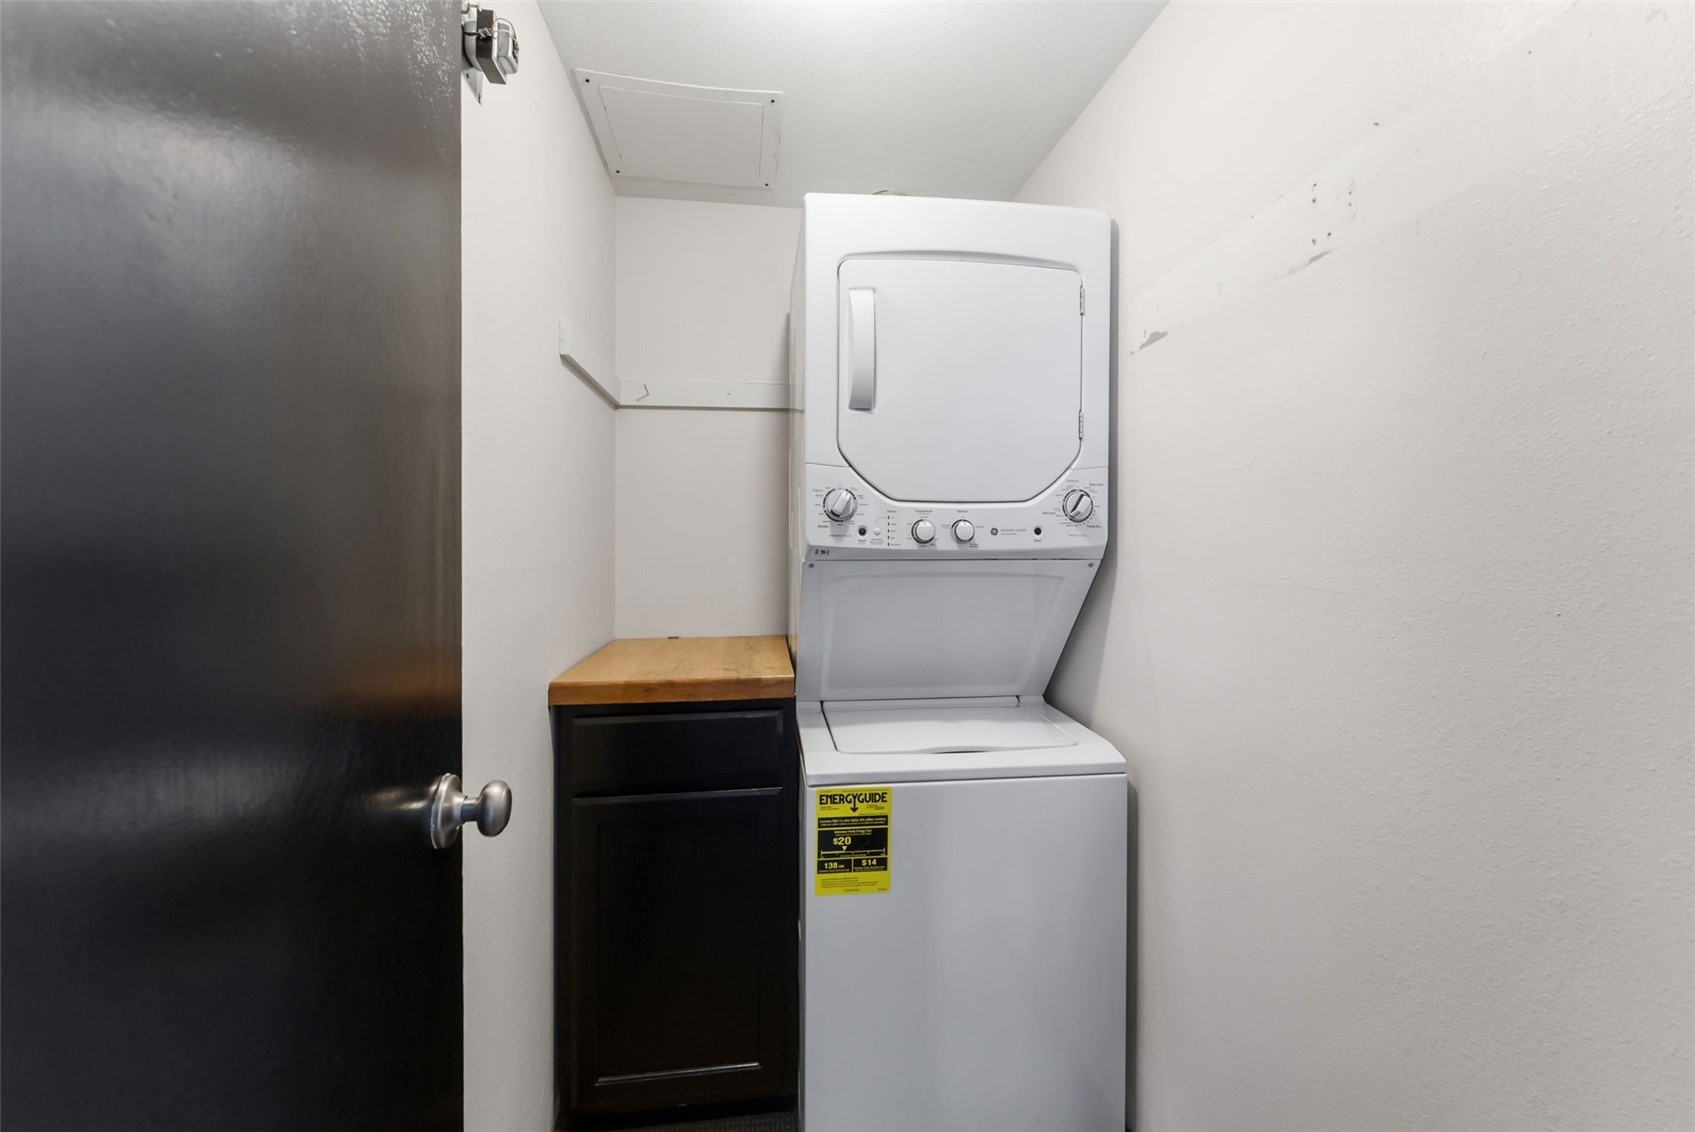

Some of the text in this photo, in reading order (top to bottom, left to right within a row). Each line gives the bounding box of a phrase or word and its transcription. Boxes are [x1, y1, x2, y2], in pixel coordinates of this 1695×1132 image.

[819, 792, 888, 804] ENERGYGUIDE
[832, 836, 852, 846] $20
[823, 862, 838, 870] 138
[862, 858, 877, 866] $14
